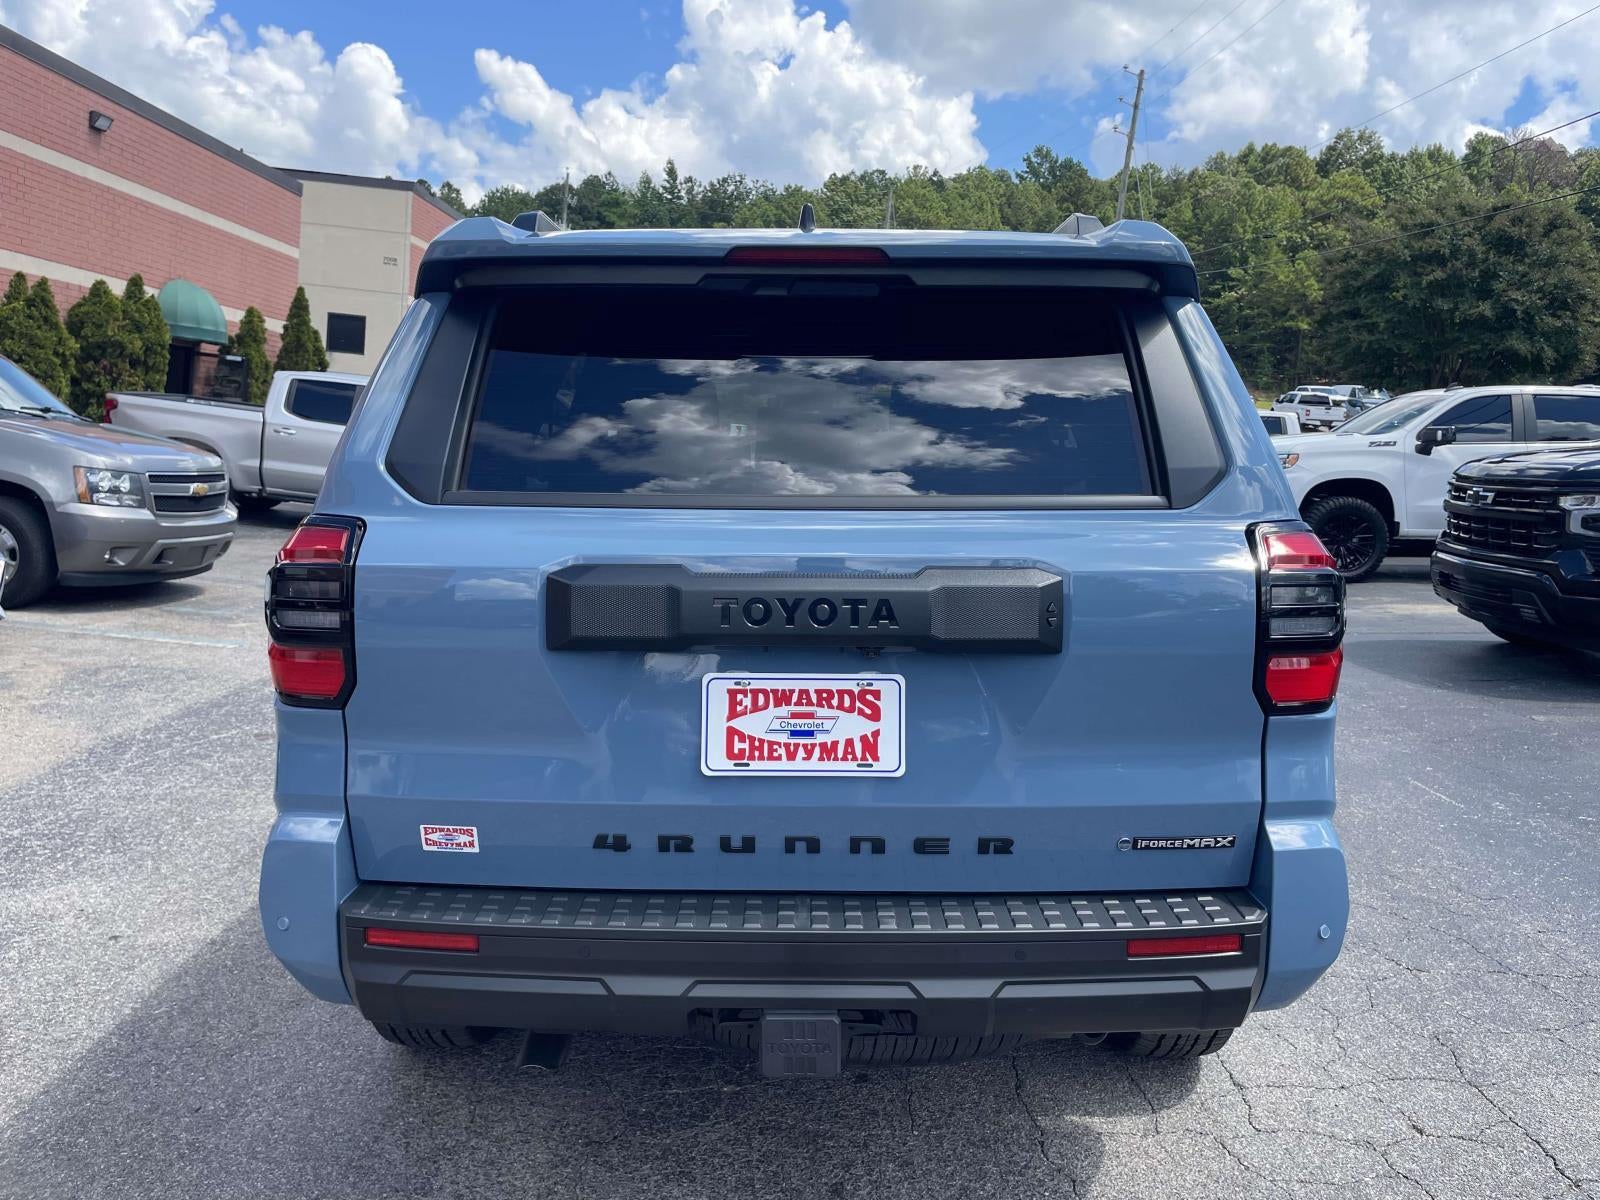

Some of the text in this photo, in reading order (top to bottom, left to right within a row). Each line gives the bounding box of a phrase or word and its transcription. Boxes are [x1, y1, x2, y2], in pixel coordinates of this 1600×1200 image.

[712, 597, 900, 629] TOYOTA
[726, 688, 882, 723] EDWARDS
[779, 720, 825, 730] Chevrolet
[725, 726, 881, 763] CHEVYMAN
[423, 826, 474, 838] EDWARDS
[424, 837, 475, 848] CHEVYMAN
[592, 833, 1015, 855] 4RUNNER
[767, 1042, 833, 1056] TOYOTA
